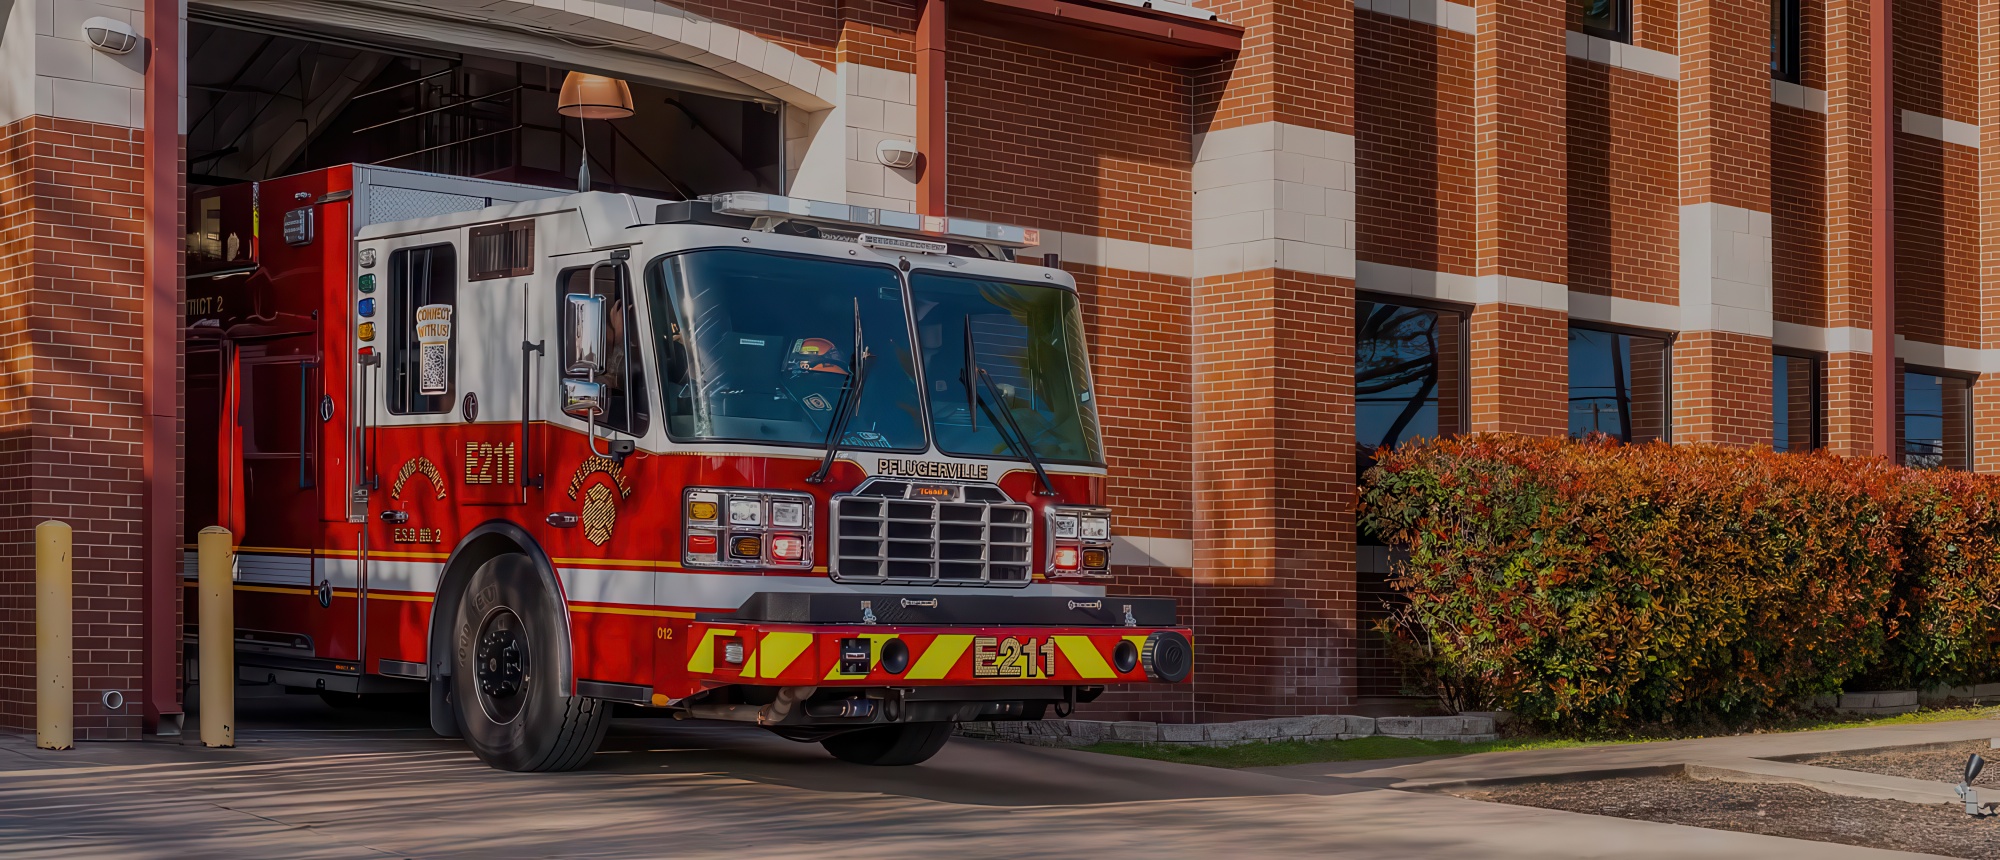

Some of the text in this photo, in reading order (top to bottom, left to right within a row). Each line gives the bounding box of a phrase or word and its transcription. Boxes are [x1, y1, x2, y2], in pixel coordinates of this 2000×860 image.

[216, 295, 224, 313] 2
[417, 307, 450, 321] CONNECT
[417, 324, 437, 337] WITH
[465, 441, 515, 485] E211
[878, 459, 988, 480] PFLUGERVILLE
[391, 457, 417, 500] TRAVIS
[435, 528, 442, 543] 2
[657, 626, 673, 640] 012
[973, 635, 1056, 678] E211
